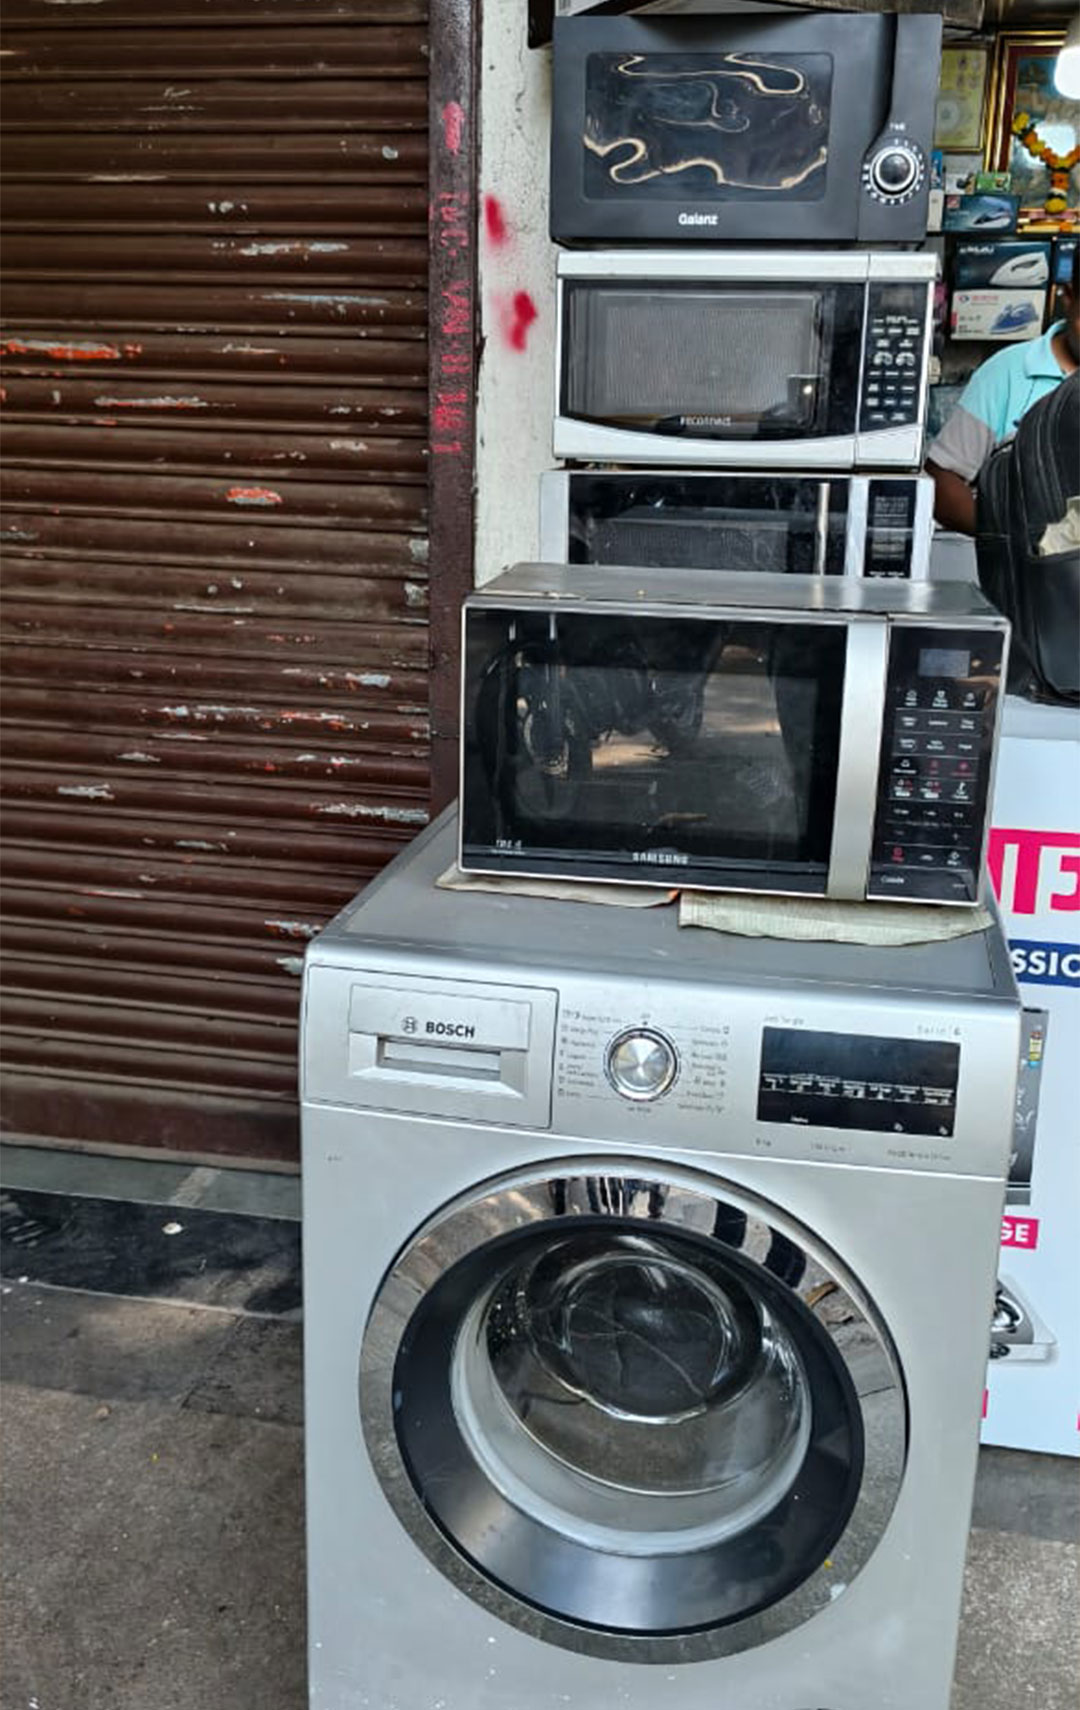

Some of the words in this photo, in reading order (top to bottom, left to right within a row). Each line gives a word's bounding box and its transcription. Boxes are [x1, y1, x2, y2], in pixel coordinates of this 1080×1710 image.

[678, 211, 719, 226] Galanz
[631, 851, 689, 865] SAMSUNG
[425, 1021, 475, 1039] BOSCH
